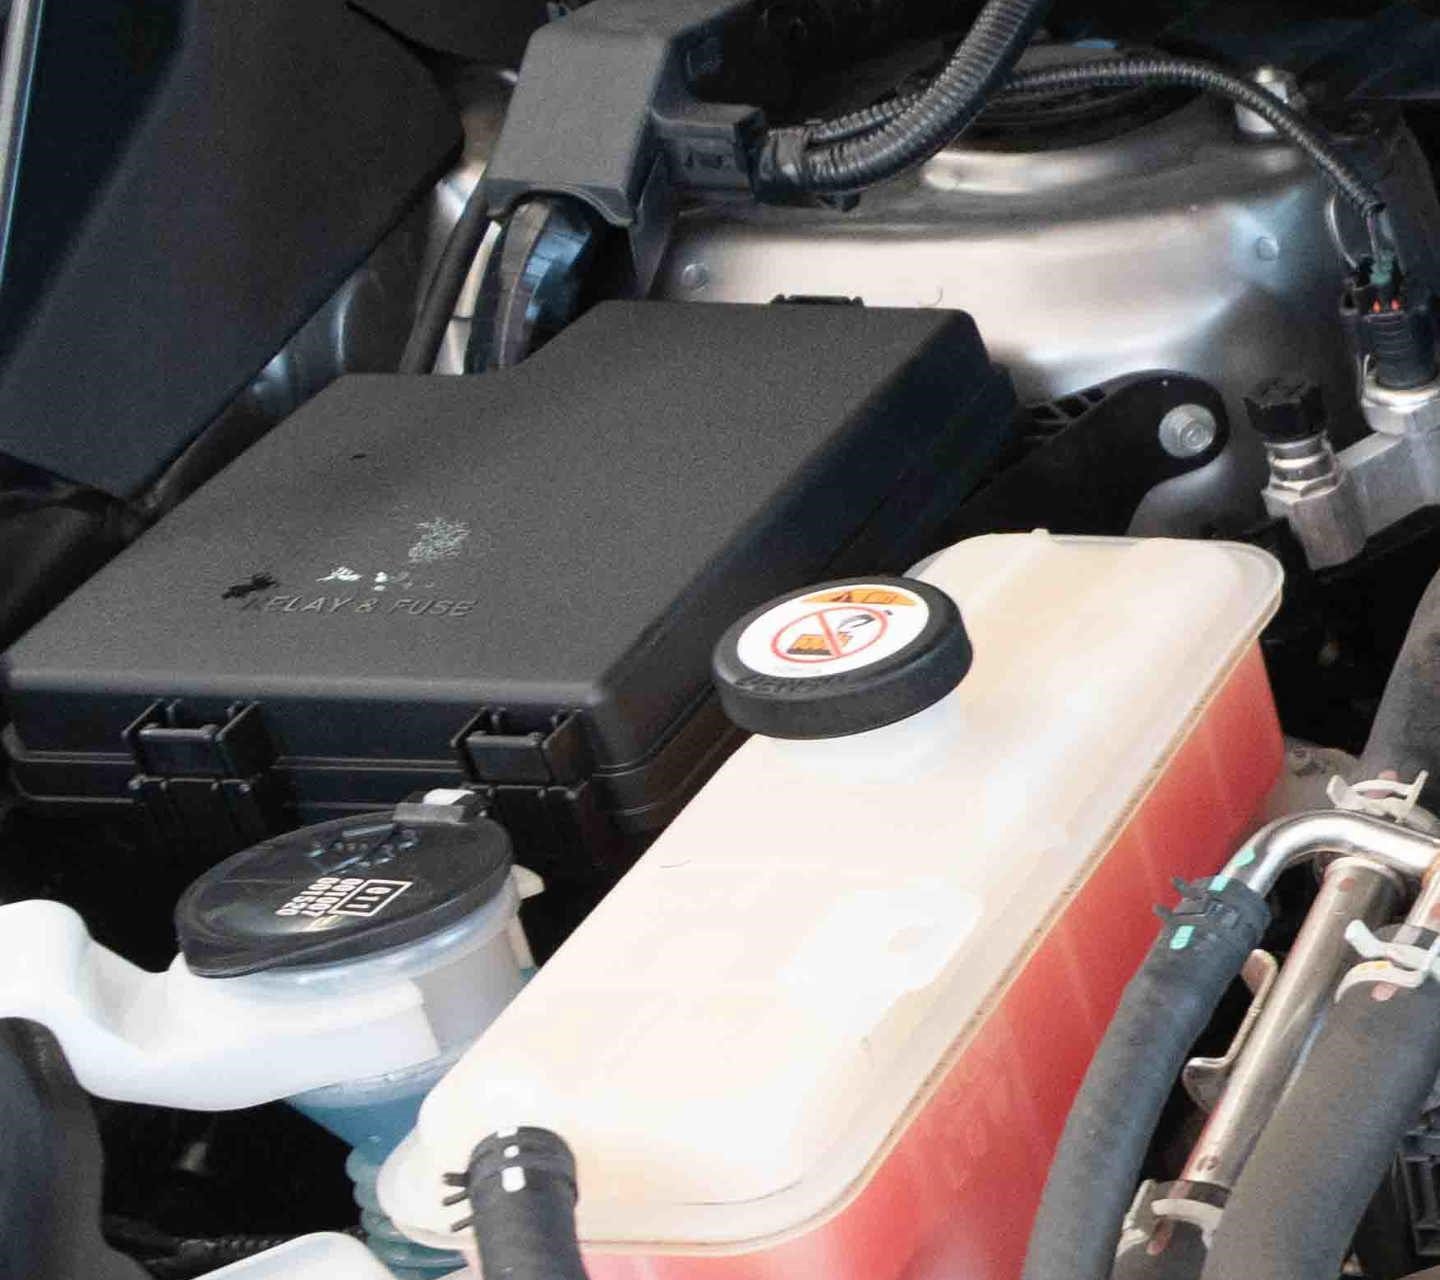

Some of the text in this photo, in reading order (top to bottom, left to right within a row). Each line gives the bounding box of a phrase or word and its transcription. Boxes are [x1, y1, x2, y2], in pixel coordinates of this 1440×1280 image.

[355, 597, 379, 614] &
[387, 598, 479, 617] FUSE
[275, 876, 341, 917] 001520
[300, 877, 364, 918] 001007
[344, 886, 393, 910] 011
